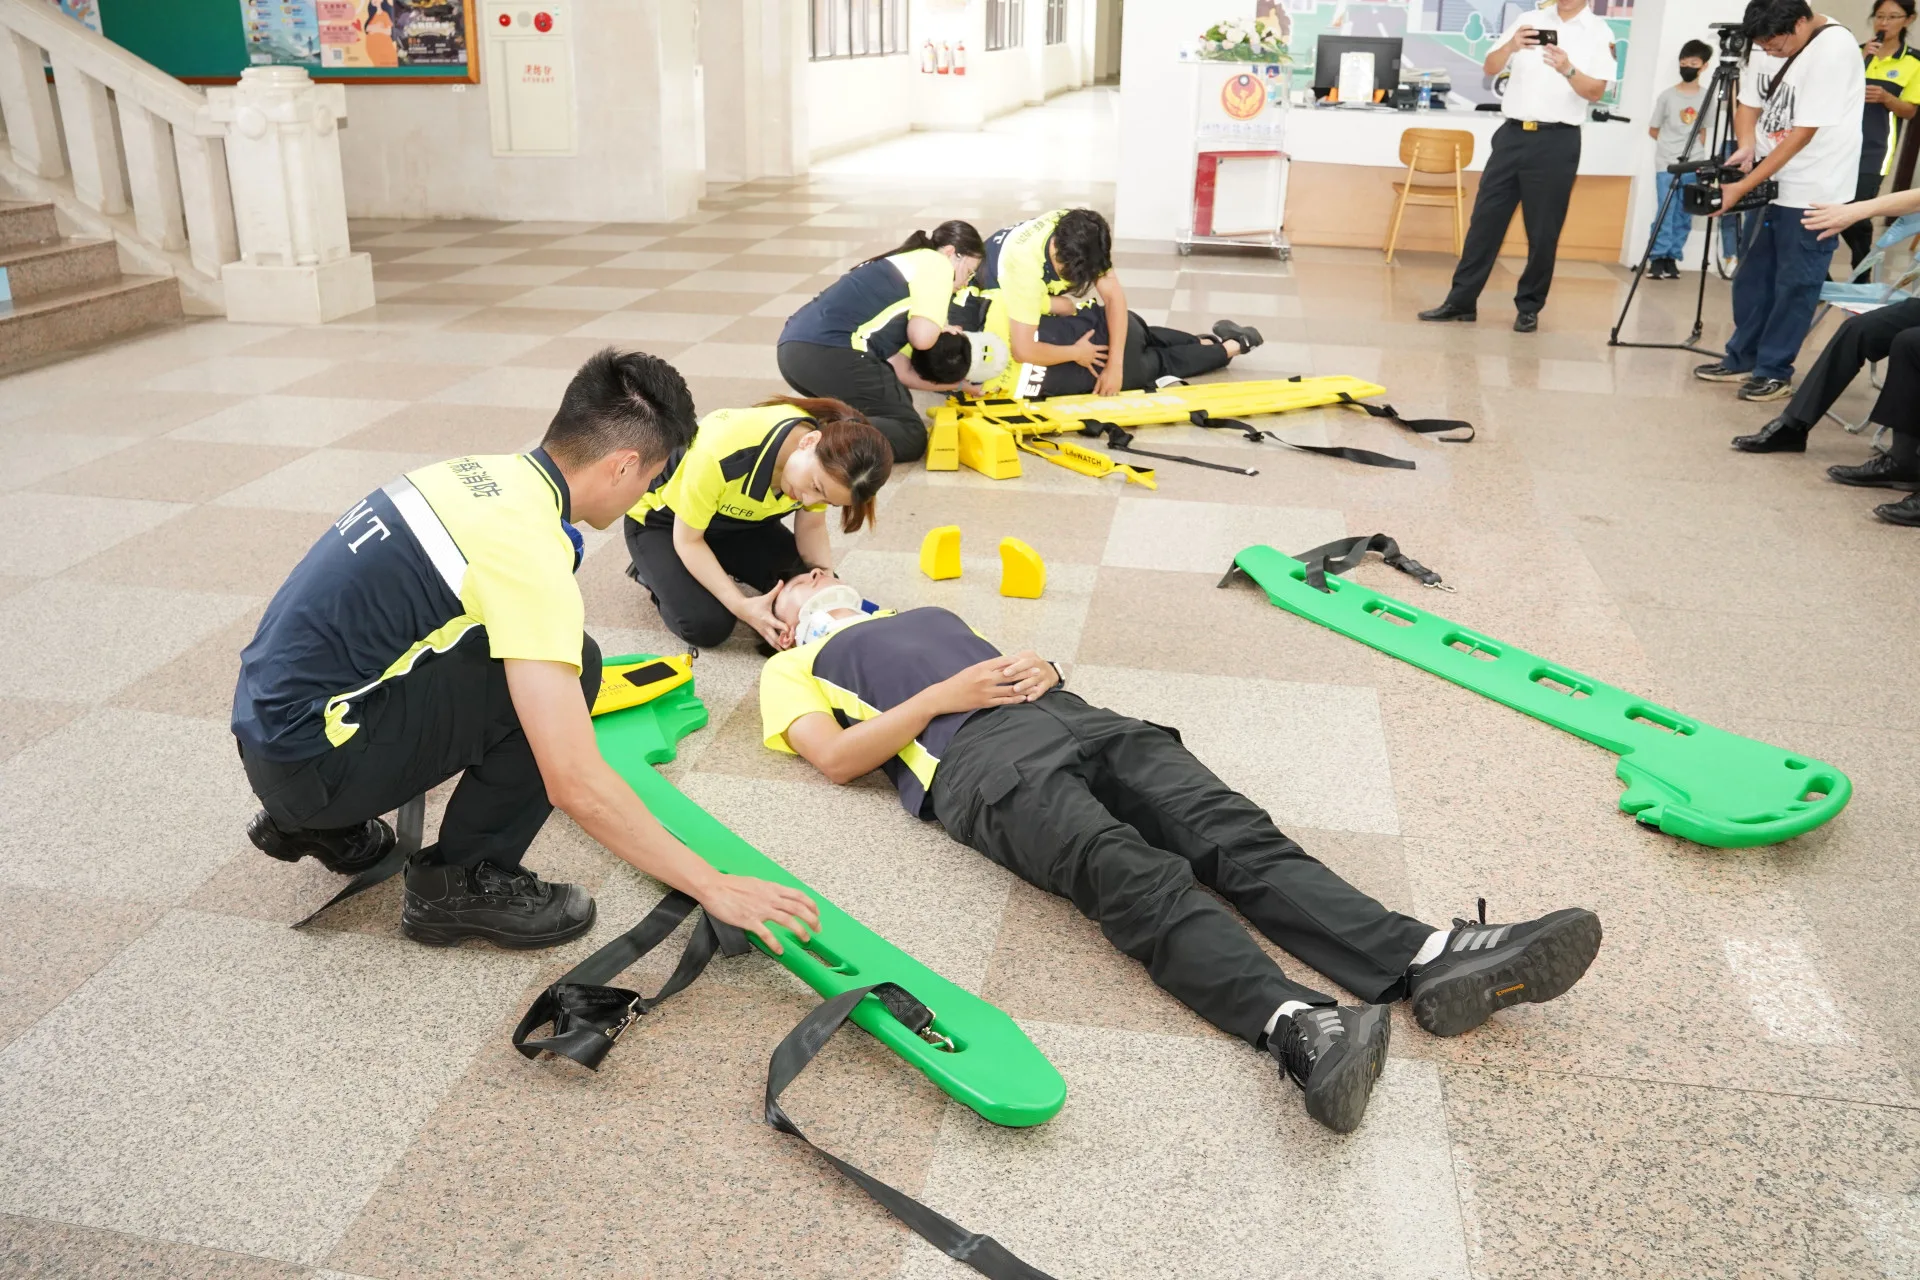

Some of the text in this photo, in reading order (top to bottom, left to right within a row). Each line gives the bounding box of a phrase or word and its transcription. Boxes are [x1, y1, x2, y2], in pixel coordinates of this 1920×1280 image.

[1024, 364, 1048, 397] EM
[1065, 448, 1102, 467] LifeWATCH
[720, 503, 755, 517] HCFB
[335, 498, 391, 554] MT
